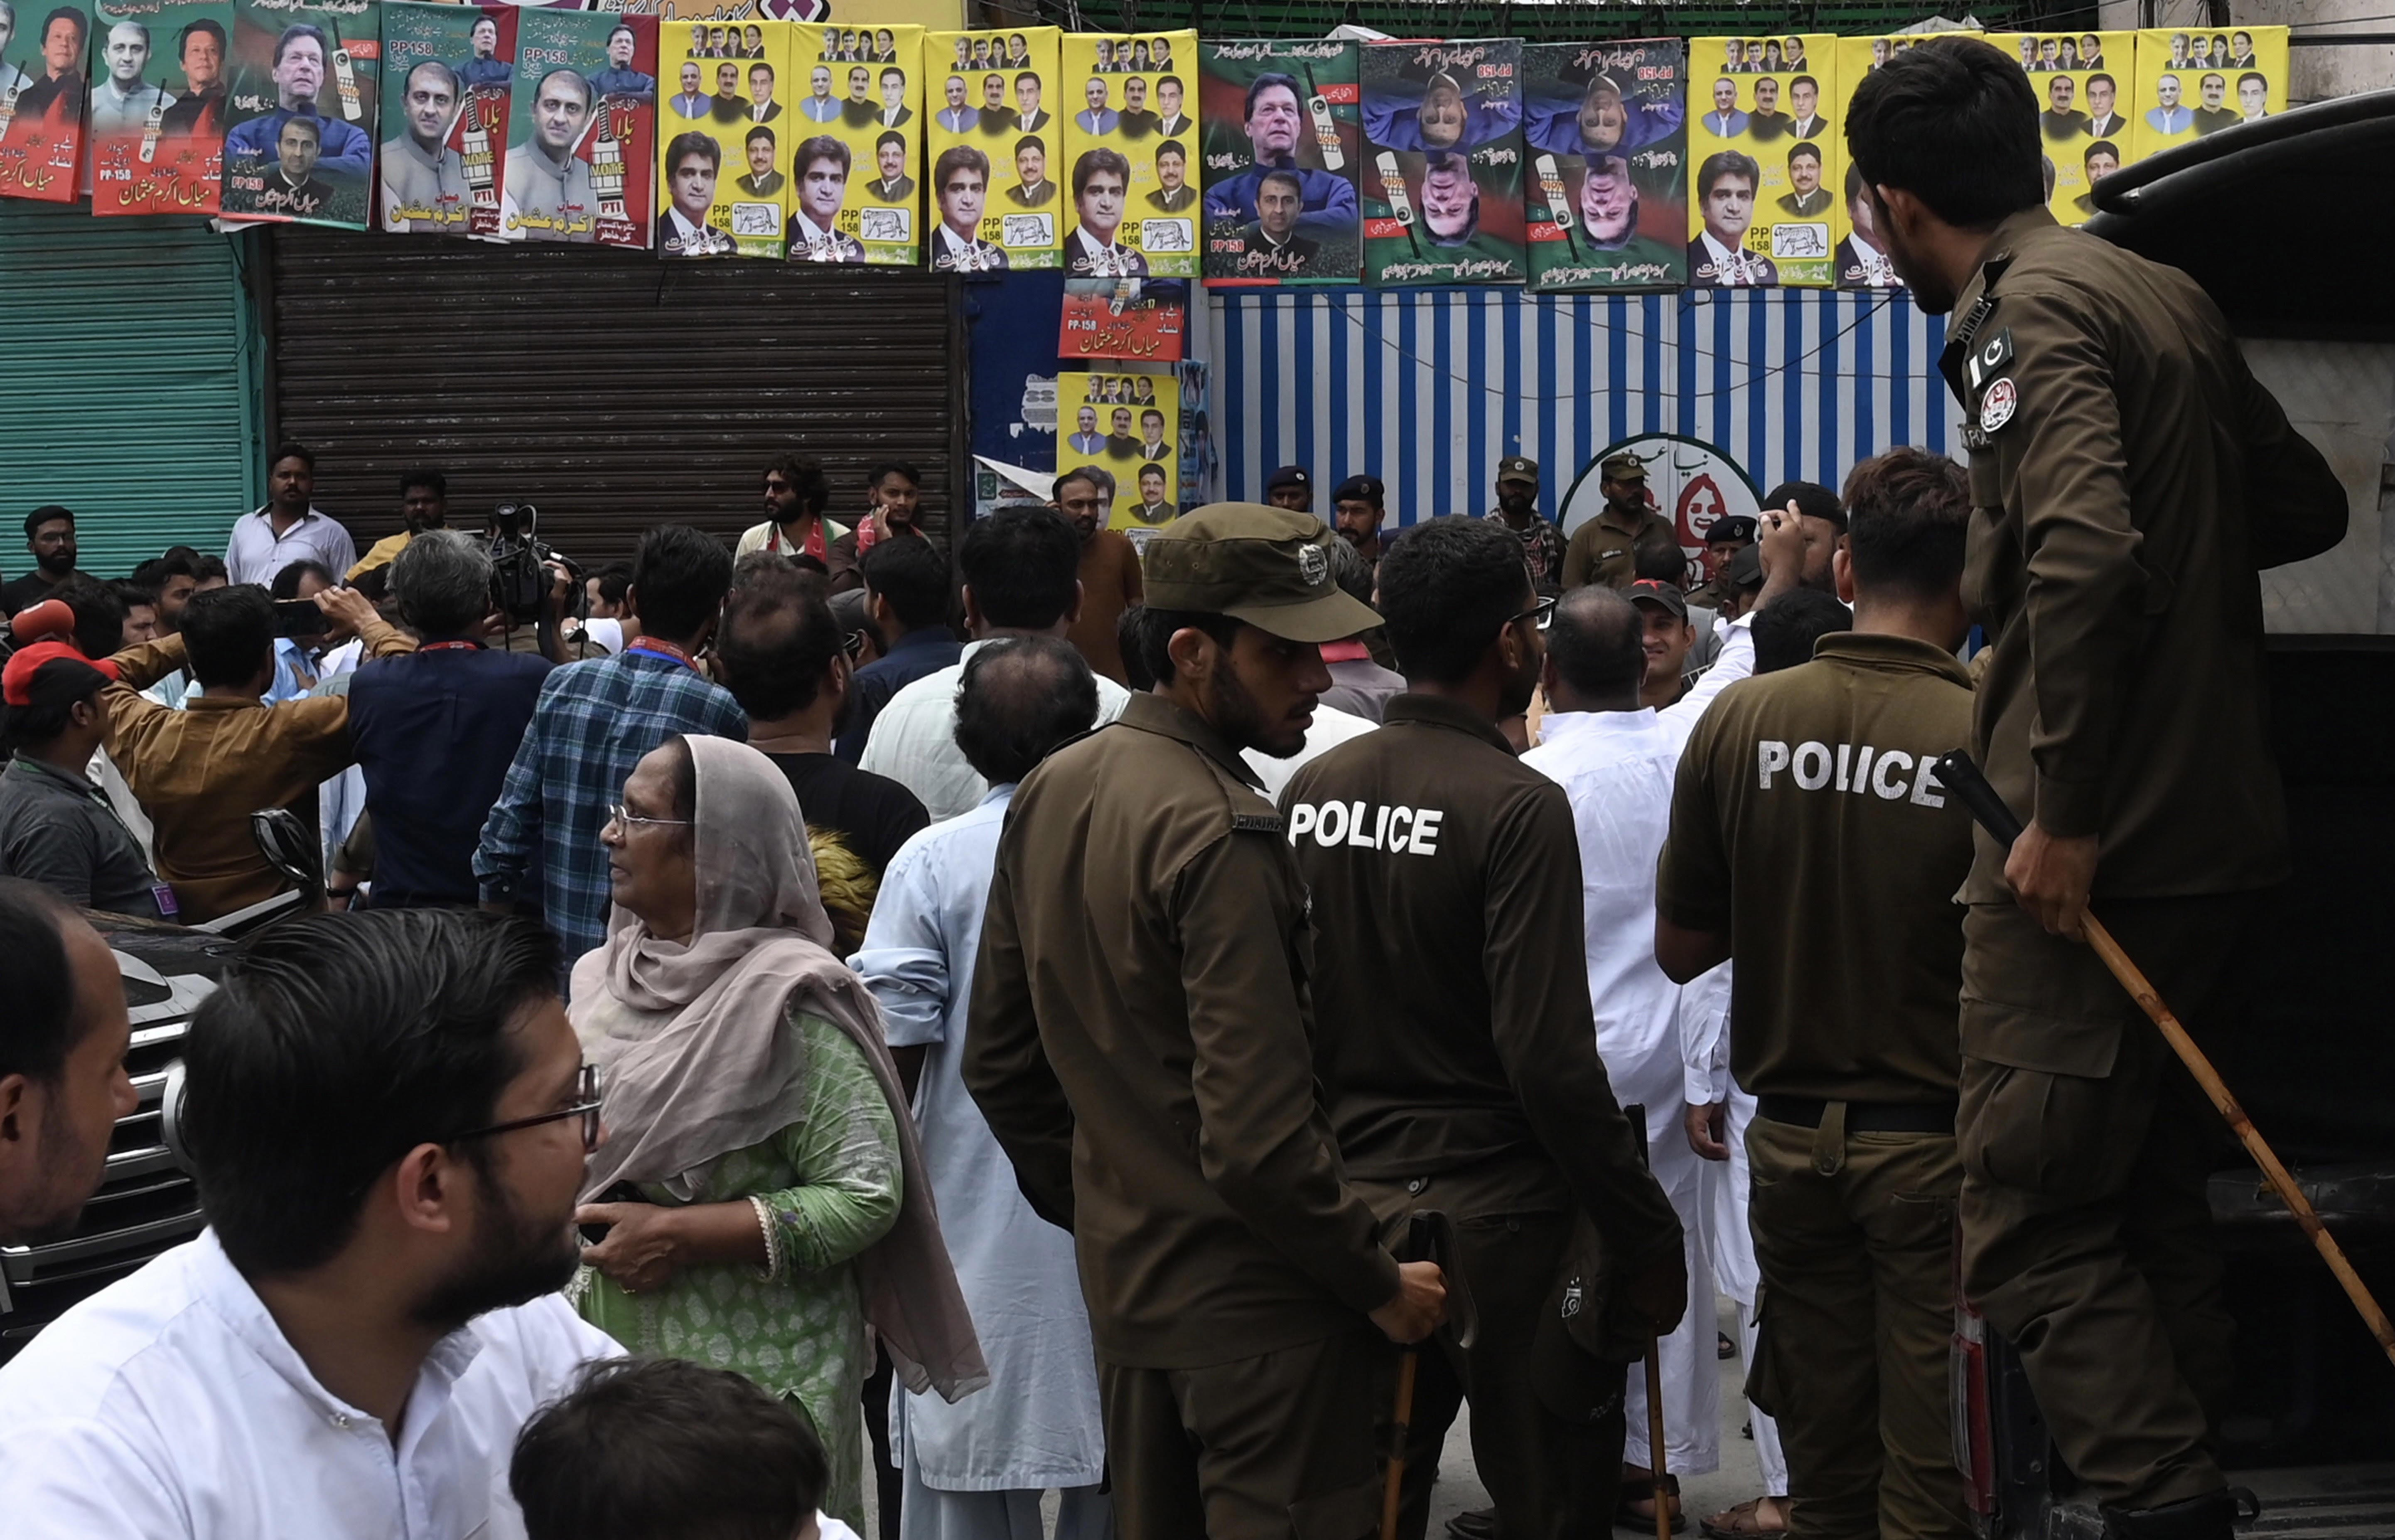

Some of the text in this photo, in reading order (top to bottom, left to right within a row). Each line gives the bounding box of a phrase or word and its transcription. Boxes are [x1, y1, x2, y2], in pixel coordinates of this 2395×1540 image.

[1413, 47, 1441, 68] میاں
[1437, 42, 1462, 74] اکرم
[1573, 49, 1602, 71] میاں
[1597, 44, 1621, 76] اکرم
[616, 114, 635, 145] بلا
[1317, 133, 1341, 145] Vote
[462, 151, 494, 166] VOTE
[100, 169, 131, 181] PP-158
[590, 162, 626, 176] VOTE
[23, 167, 54, 191] میاں
[1539, 180, 1565, 191] Vote
[119, 176, 210, 210] میاں اکرم عثمان
[474, 190, 493, 203] PTI
[275, 186, 298, 215] اکرم
[293, 193, 320, 213] میاں
[600, 201, 621, 213] PTI
[390, 199, 469, 225] اکرم عثمان
[713, 204, 730, 216] PP
[841, 209, 859, 221] PP
[506, 207, 594, 235] اکرم عثمان
[713, 217, 730, 228] 158
[841, 222, 859, 233] 158
[983, 218, 1000, 229] PP
[1122, 222, 1140, 234] PP
[983, 231, 1002, 241] 158
[1122, 235, 1140, 245] 158
[1750, 227, 1769, 239] PP
[1226, 239, 1245, 253] 158
[1750, 241, 1769, 250] 158
[1258, 245, 1283, 275] اکرم
[1277, 250, 1305, 272] میاں
[1696, 254, 1734, 283] شرافت
[1845, 256, 1883, 285] شرافت
[1147, 298, 1155, 309] 17
[1068, 319, 1097, 331] PP-158
[1080, 328, 1160, 356] میاں اکرم عثمان
[1674, 450, 1708, 477] نیا
[1288, 800, 1444, 856] POLICE
